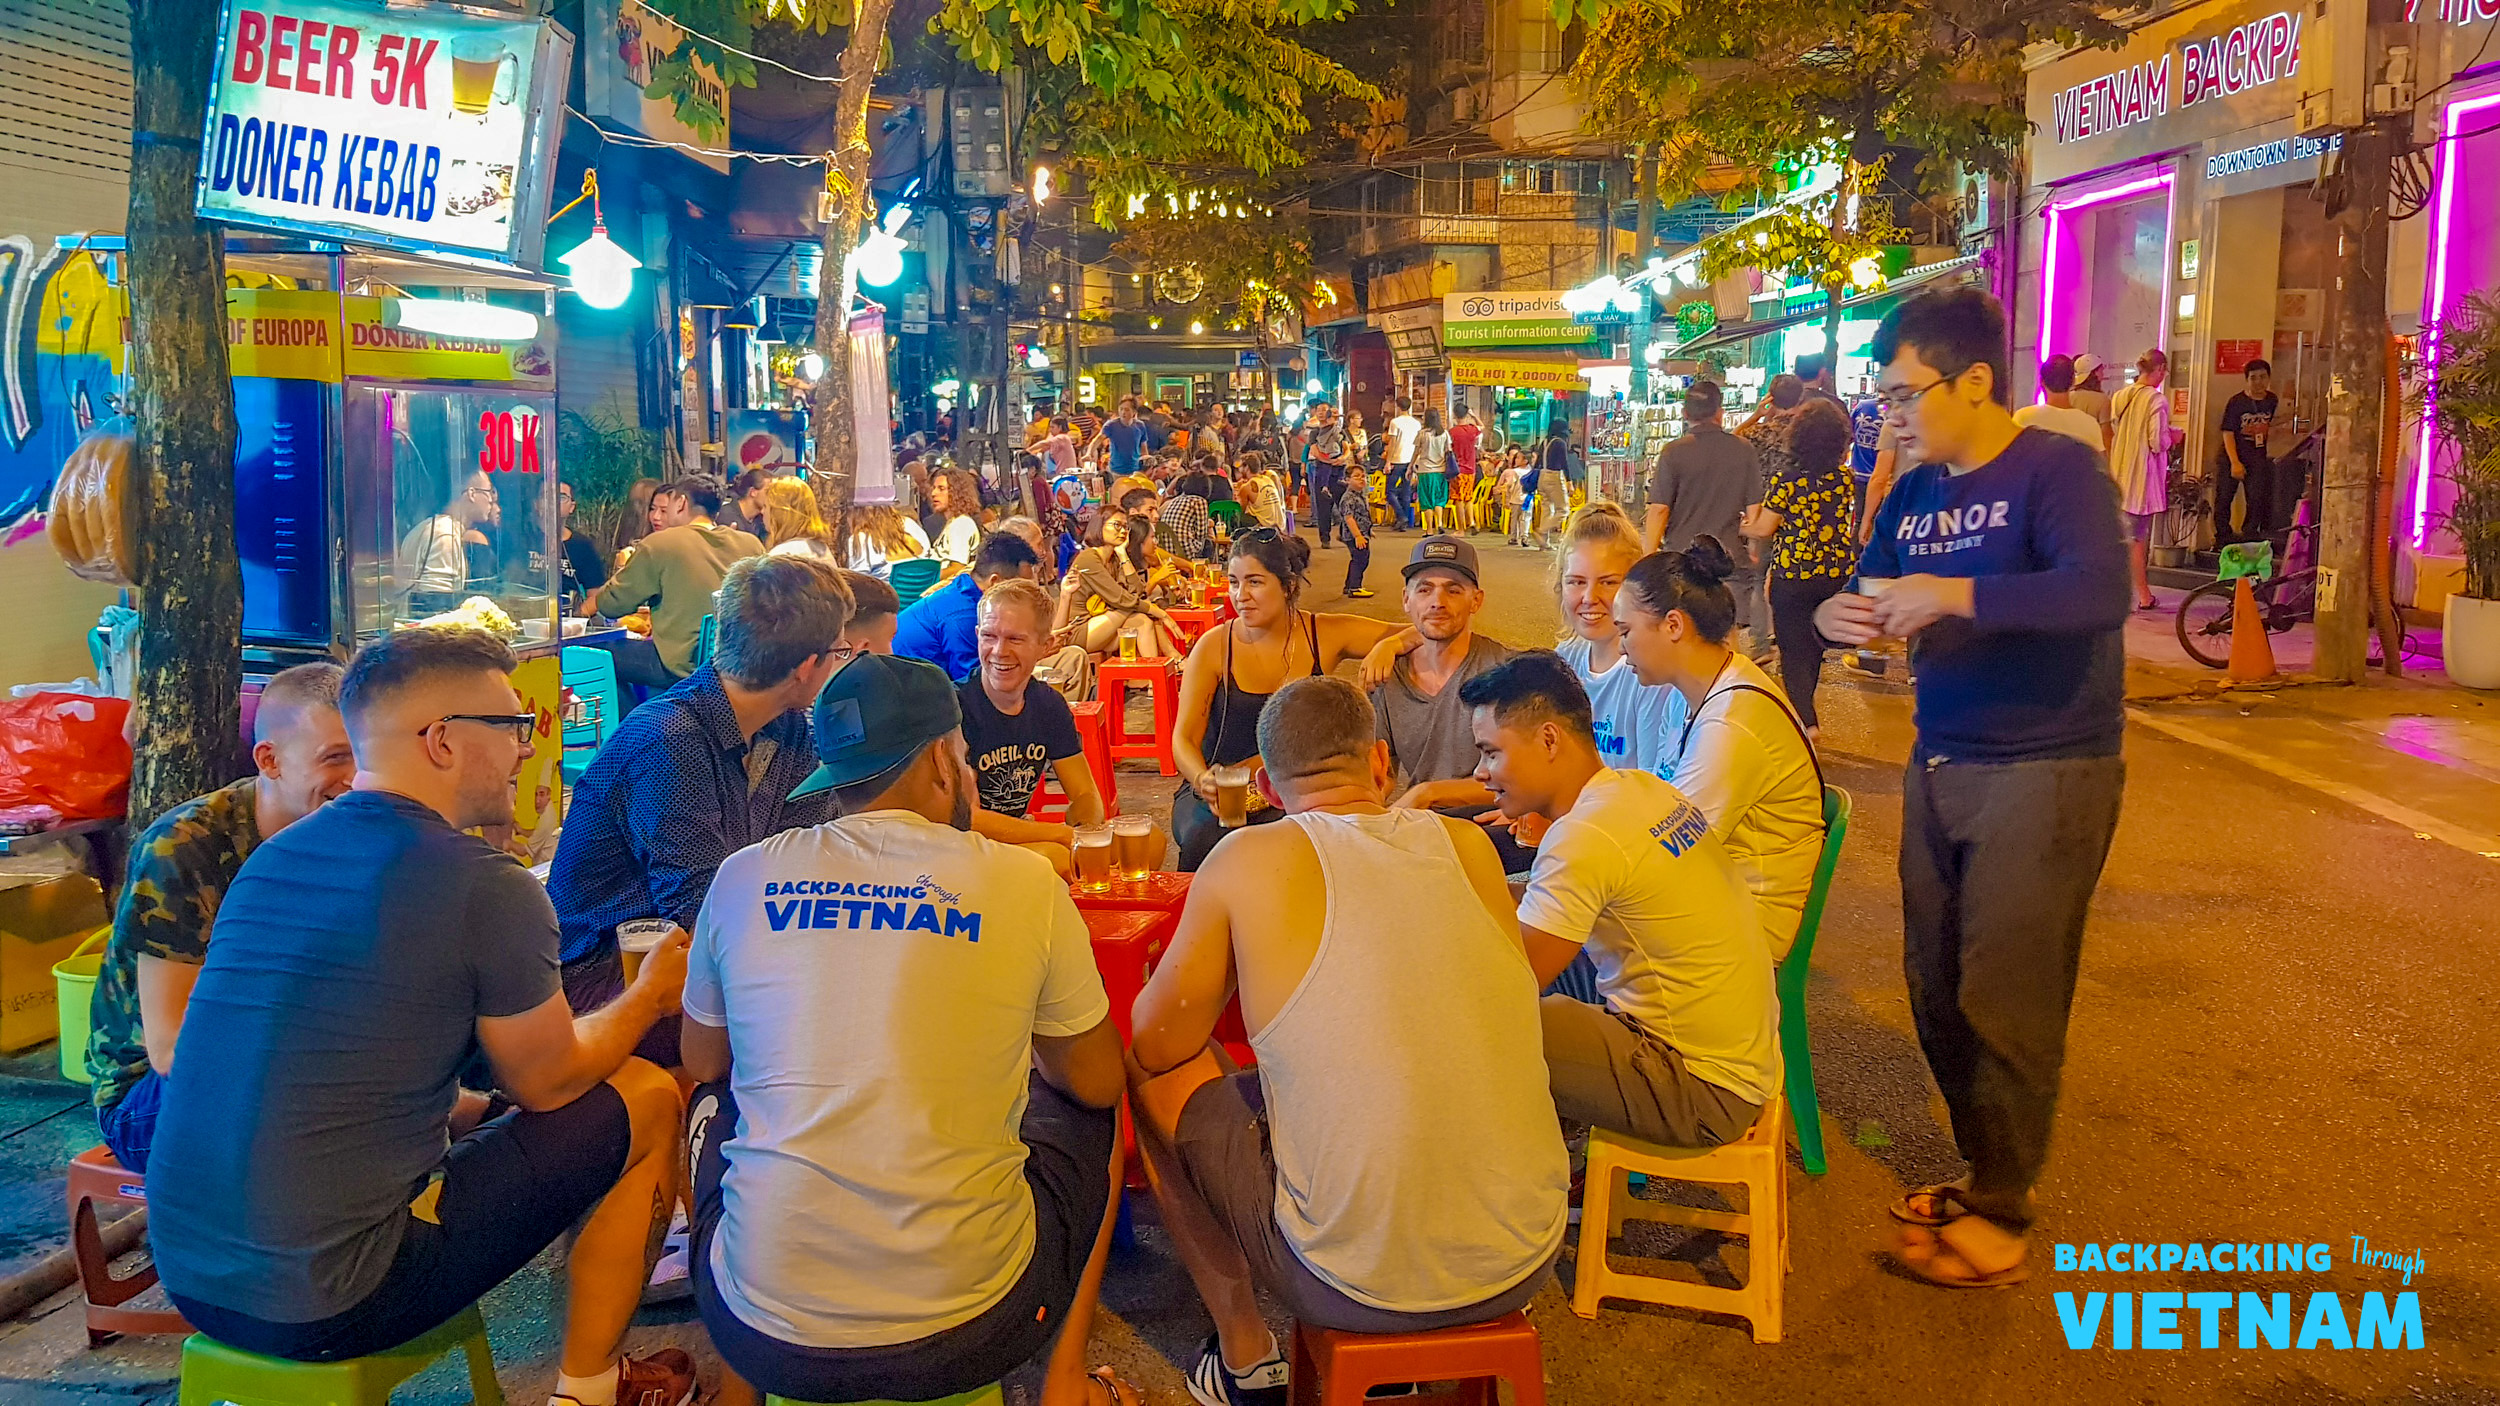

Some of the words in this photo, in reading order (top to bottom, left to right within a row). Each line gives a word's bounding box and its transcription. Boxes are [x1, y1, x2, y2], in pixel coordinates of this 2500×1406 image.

[232, 9, 360, 100] BEER
[370, 34, 440, 111] 5K
[2053, 53, 2171, 145] VIETNAM
[2181, 11, 2300, 109] BACKPA
[212, 113, 328, 207] DONER
[333, 133, 442, 223] KEBAB
[2206, 138, 2288, 180] DOWNTOWN
[1498, 297, 1568, 315] tripadvis
[253, 318, 329, 347] EUROPA
[1448, 327, 1489, 341] Tourist
[1491, 324, 1558, 339] information
[1560, 323, 1596, 337] centre
[1456, 368, 1479, 378] BIA
[479, 410, 515, 474] 30
[521, 414, 541, 474] K
[1896, 500, 2010, 540] HONOR
[1026, 743, 1047, 761] CO
[1648, 802, 1690, 839] BACKPACKING
[764, 880, 927, 900] BACKPACKING
[916, 873, 960, 906] through
[763, 898, 982, 944] VIETNAM
